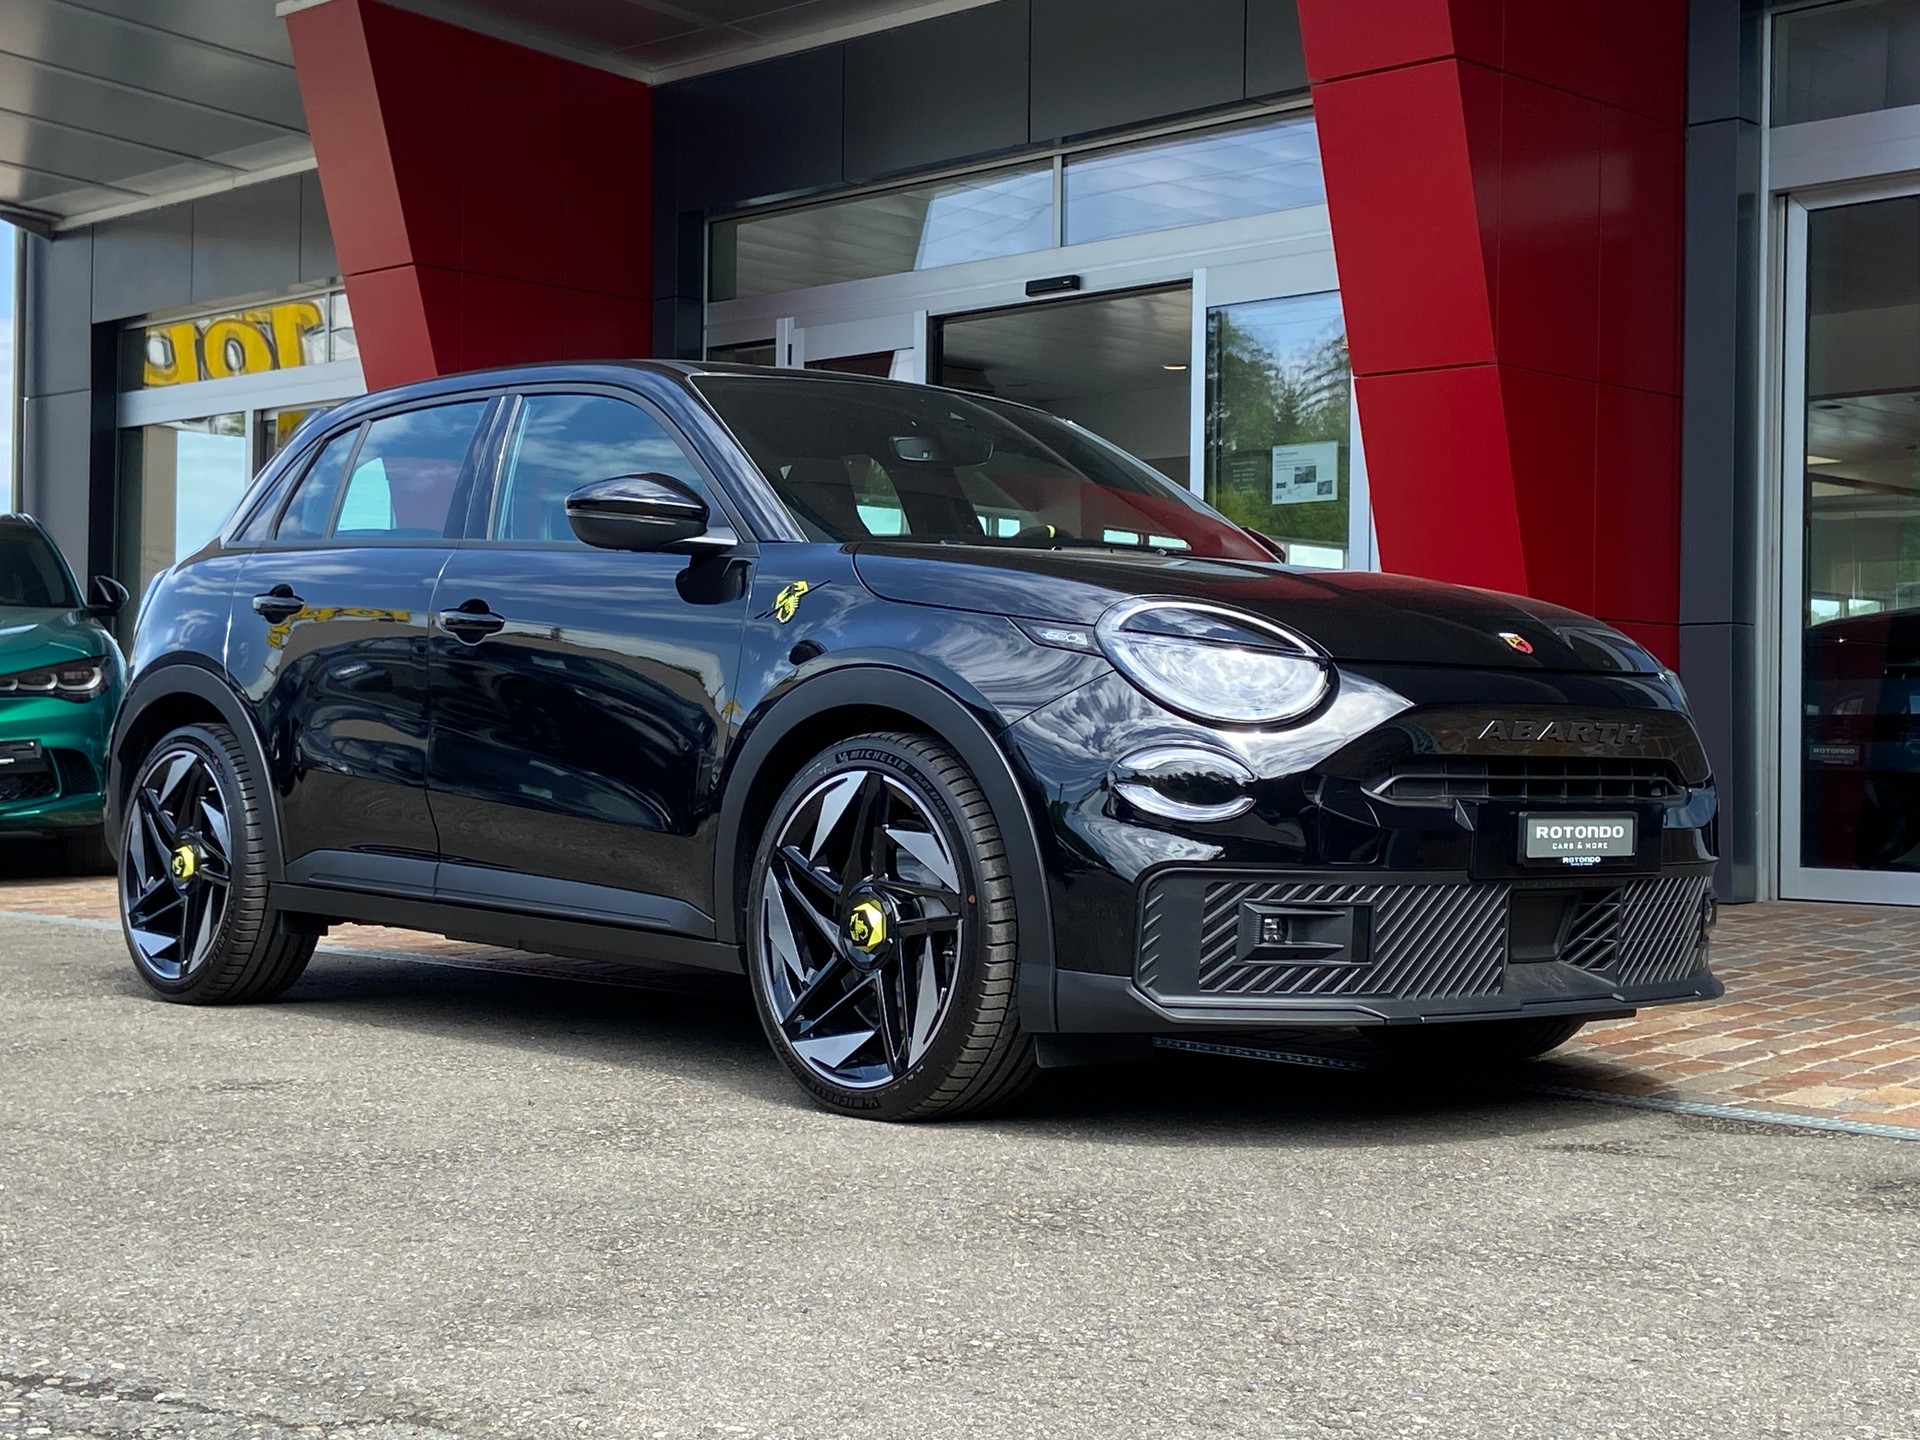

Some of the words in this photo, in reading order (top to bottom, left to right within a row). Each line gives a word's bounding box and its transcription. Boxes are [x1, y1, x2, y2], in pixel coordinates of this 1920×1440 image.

[1477, 719, 1643, 744] ABARTH
[850, 750, 908, 771] MICHELIN
[1536, 825, 1624, 839] ROTONDO
[1552, 842, 1574, 850] CARS
[1577, 841, 1583, 850] &
[1562, 856, 1602, 864] ROTONDO
